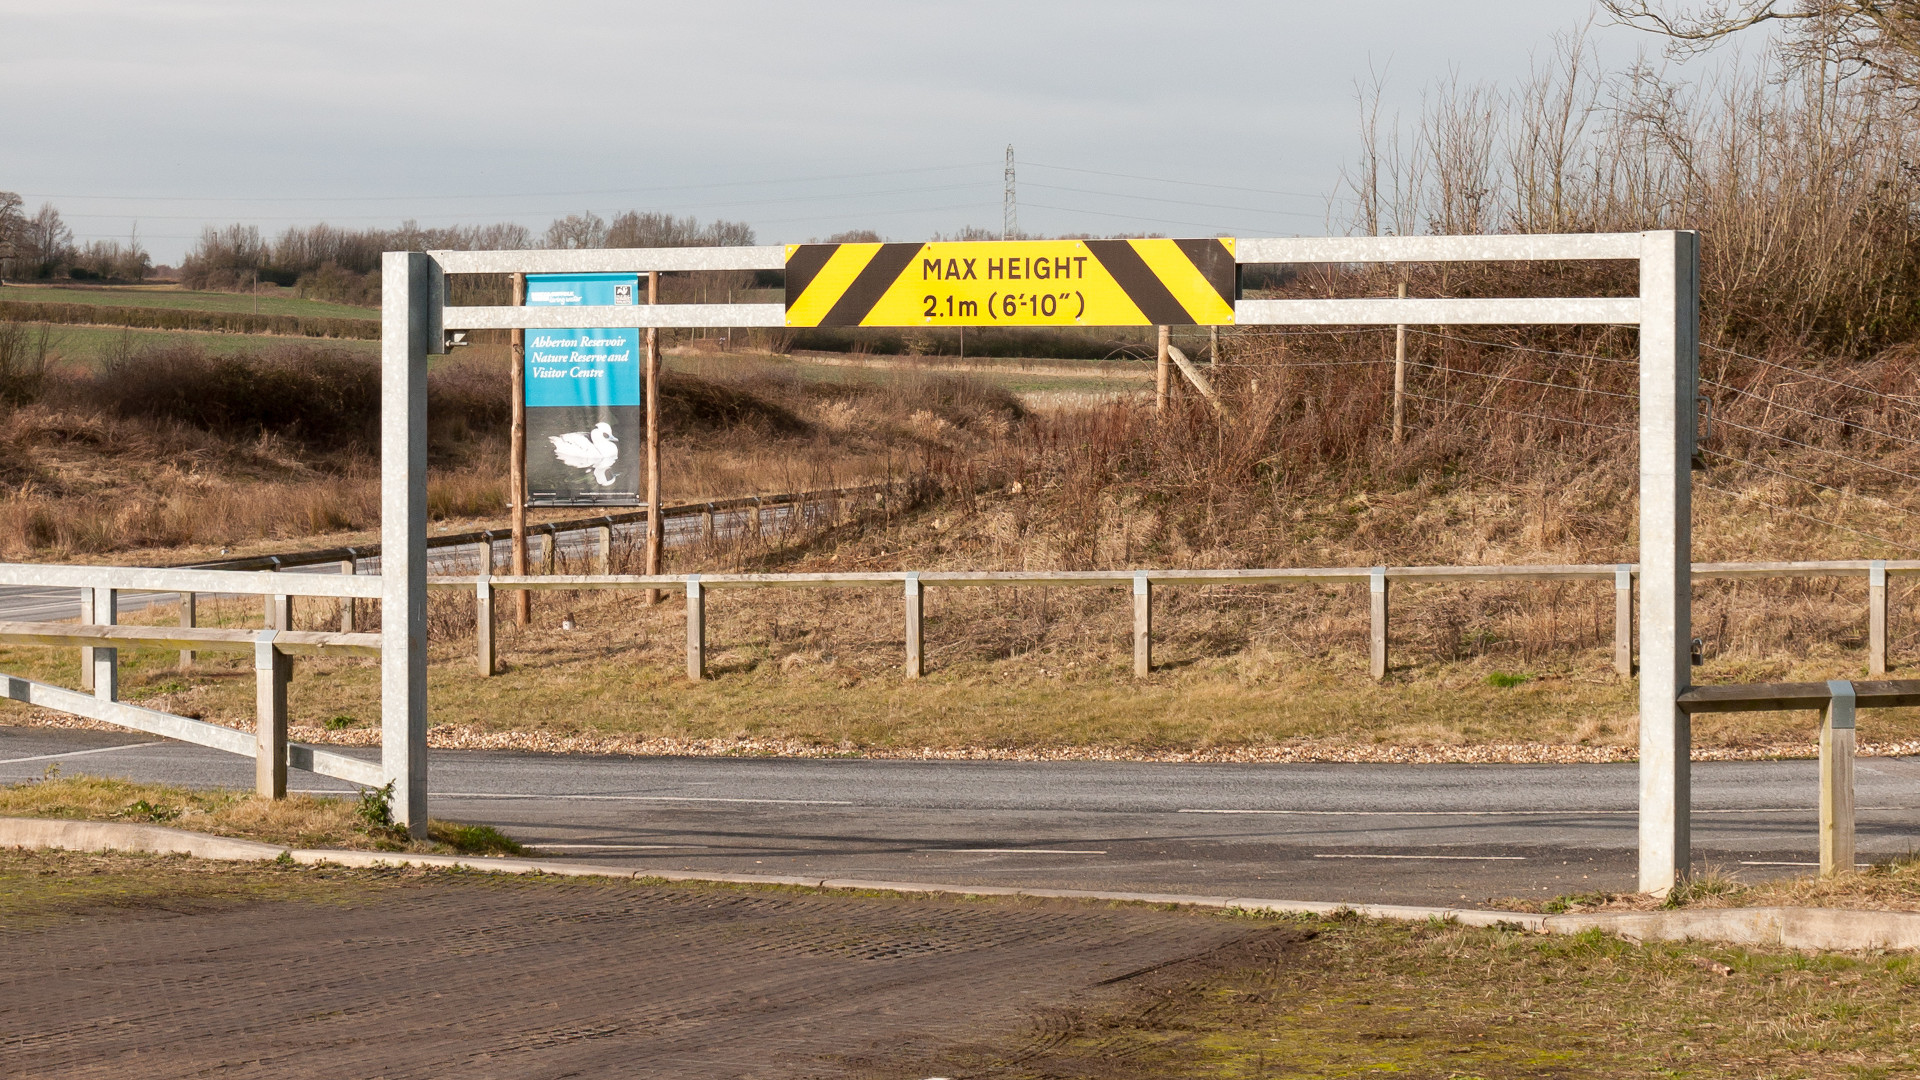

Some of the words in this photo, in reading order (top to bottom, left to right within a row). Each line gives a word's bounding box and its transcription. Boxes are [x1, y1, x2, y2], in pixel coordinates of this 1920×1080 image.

[923, 258, 977, 280] MAX
[988, 257, 1087, 280] HEIGHT
[923, 295, 977, 317] 2.1m
[530, 335, 577, 347] Abberton
[580, 335, 626, 347] Reservoir
[531, 351, 568, 363] Nature
[569, 351, 607, 362] Reserve
[608, 350, 630, 362] and
[533, 366, 567, 378] Visitor
[570, 366, 604, 378] Centre
